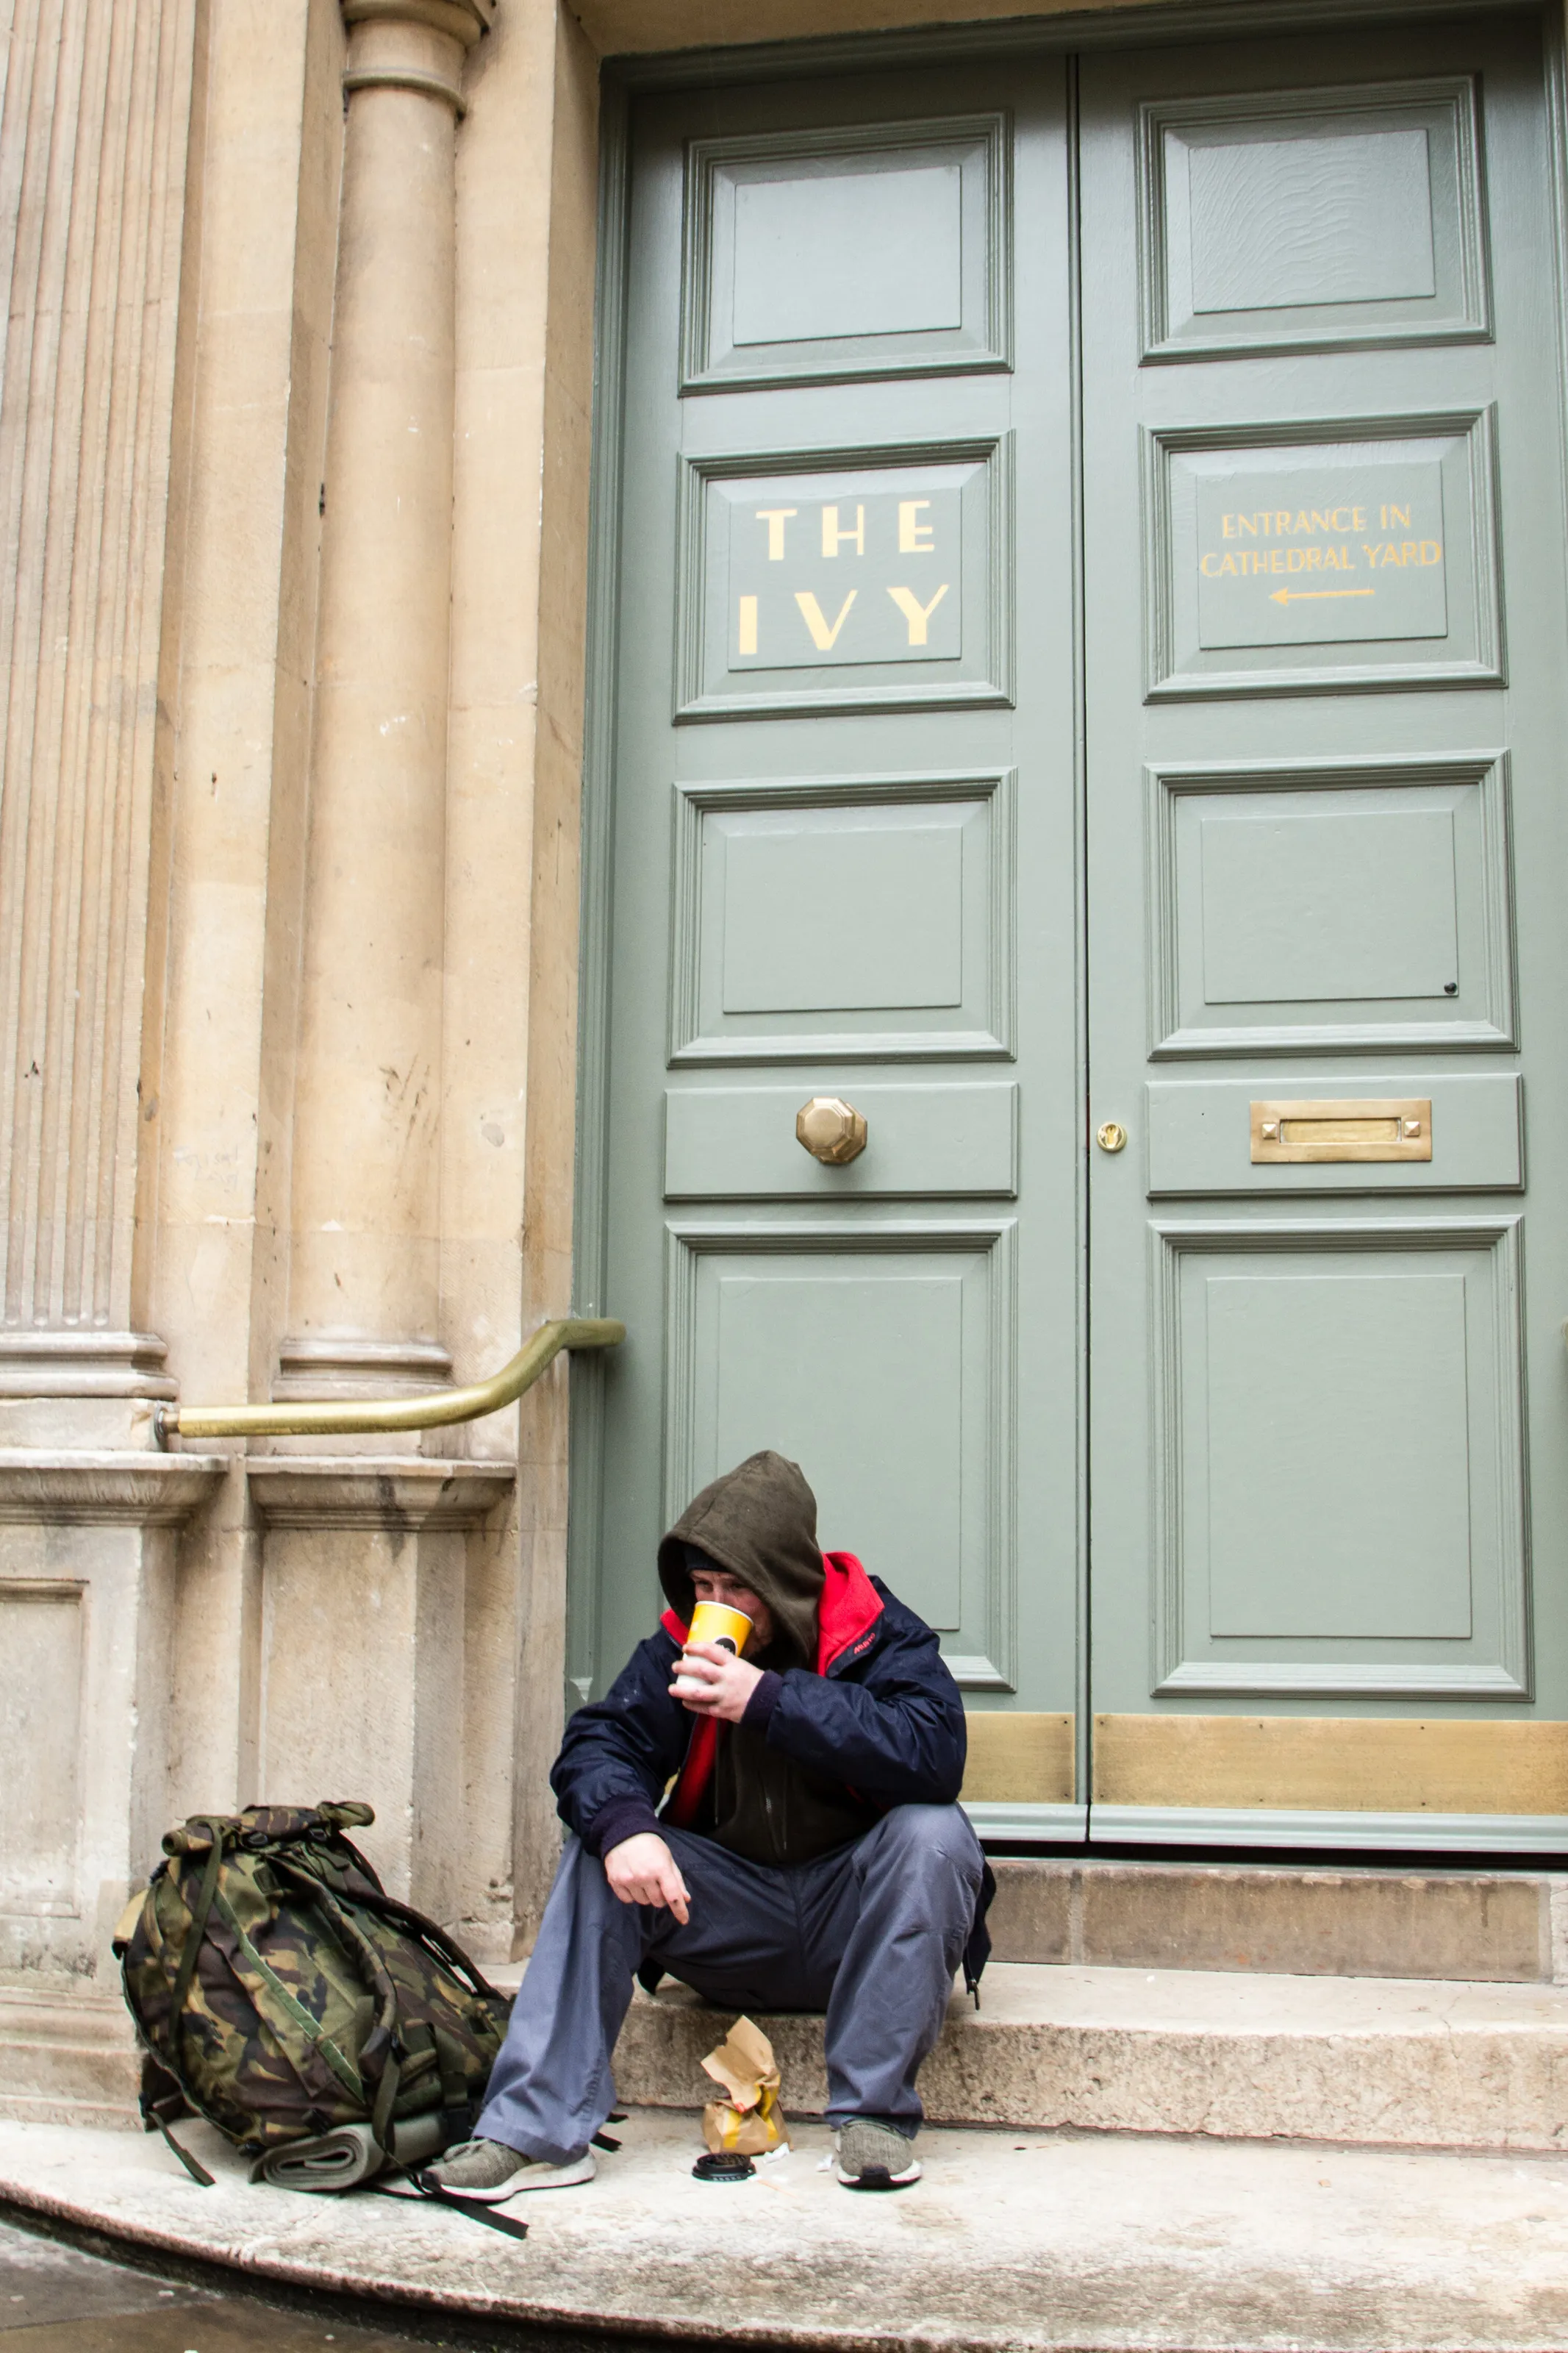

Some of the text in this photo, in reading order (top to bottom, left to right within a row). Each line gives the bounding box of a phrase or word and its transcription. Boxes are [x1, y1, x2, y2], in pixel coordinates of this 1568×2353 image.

[756, 500, 934, 560] THE
[1222, 504, 1411, 538] ENTRANCE IN
[1200, 540, 1442, 576] CATHEDRAL YARD
[739, 584, 949, 654] IVY
